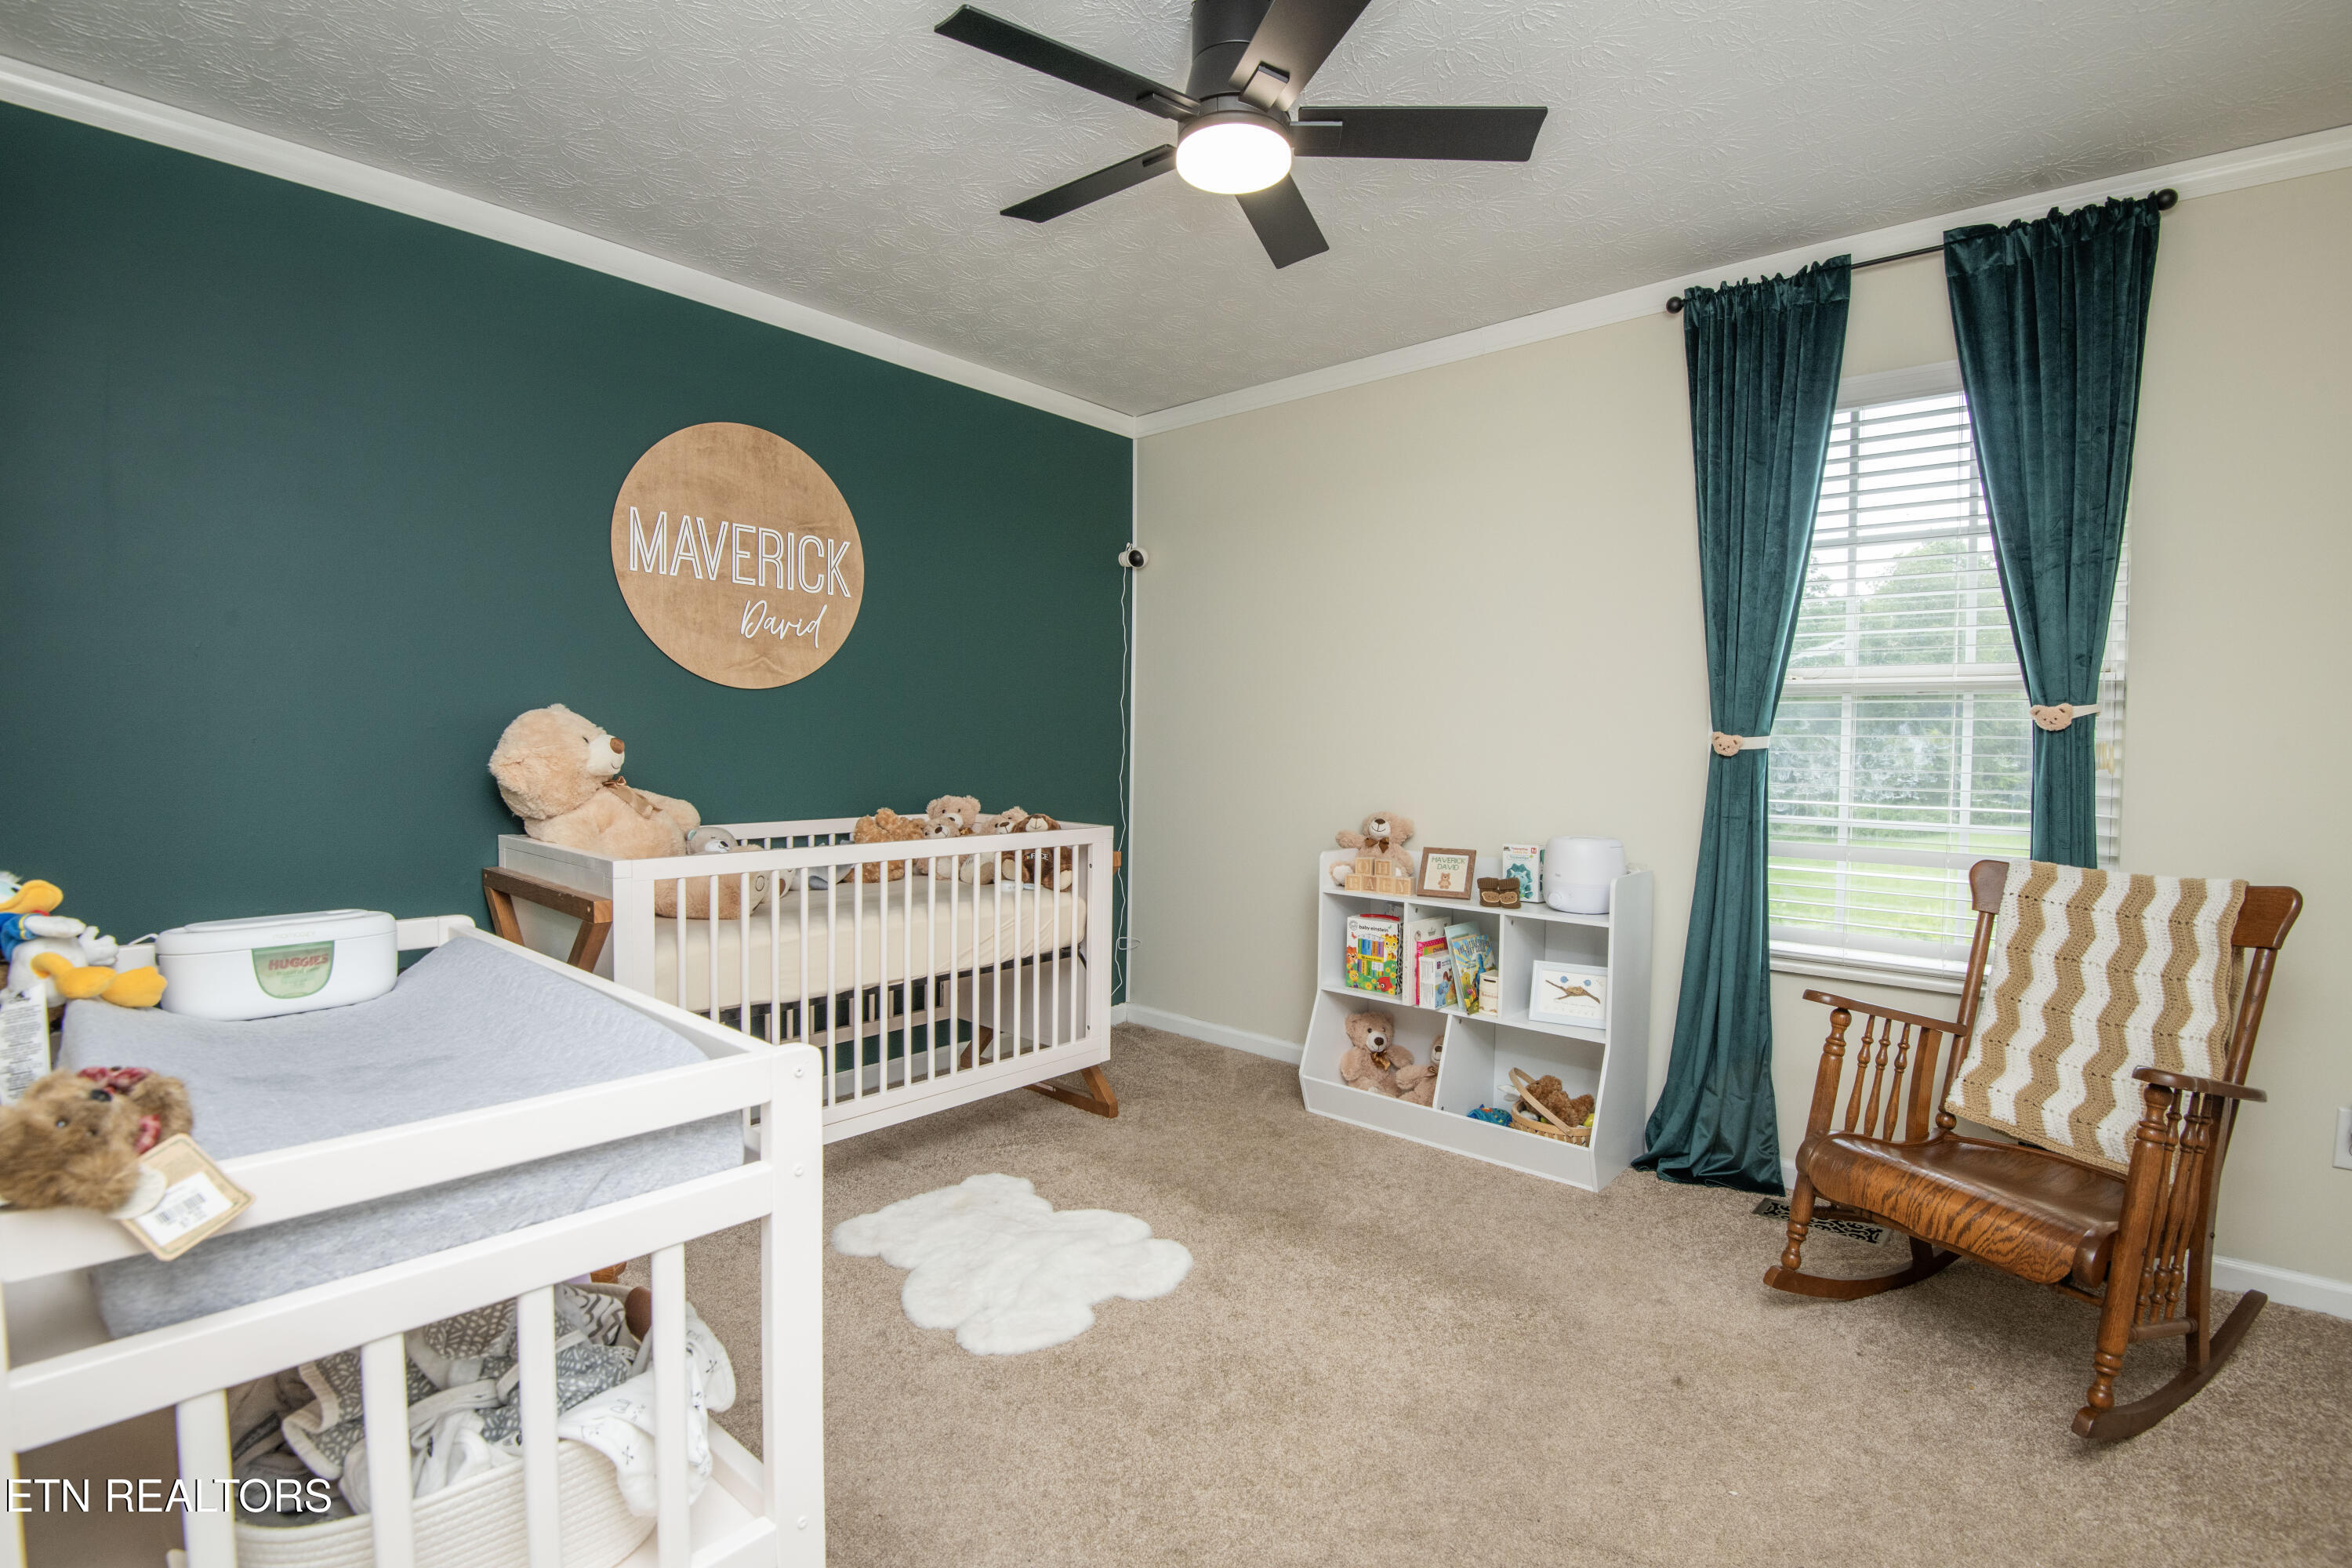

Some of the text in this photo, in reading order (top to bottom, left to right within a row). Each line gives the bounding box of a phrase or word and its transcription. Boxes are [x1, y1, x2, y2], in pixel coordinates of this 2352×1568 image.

[629, 506, 852, 598] MAVERICK
[740, 600, 828, 648] David
[268, 953, 329, 971] HUGGIES
